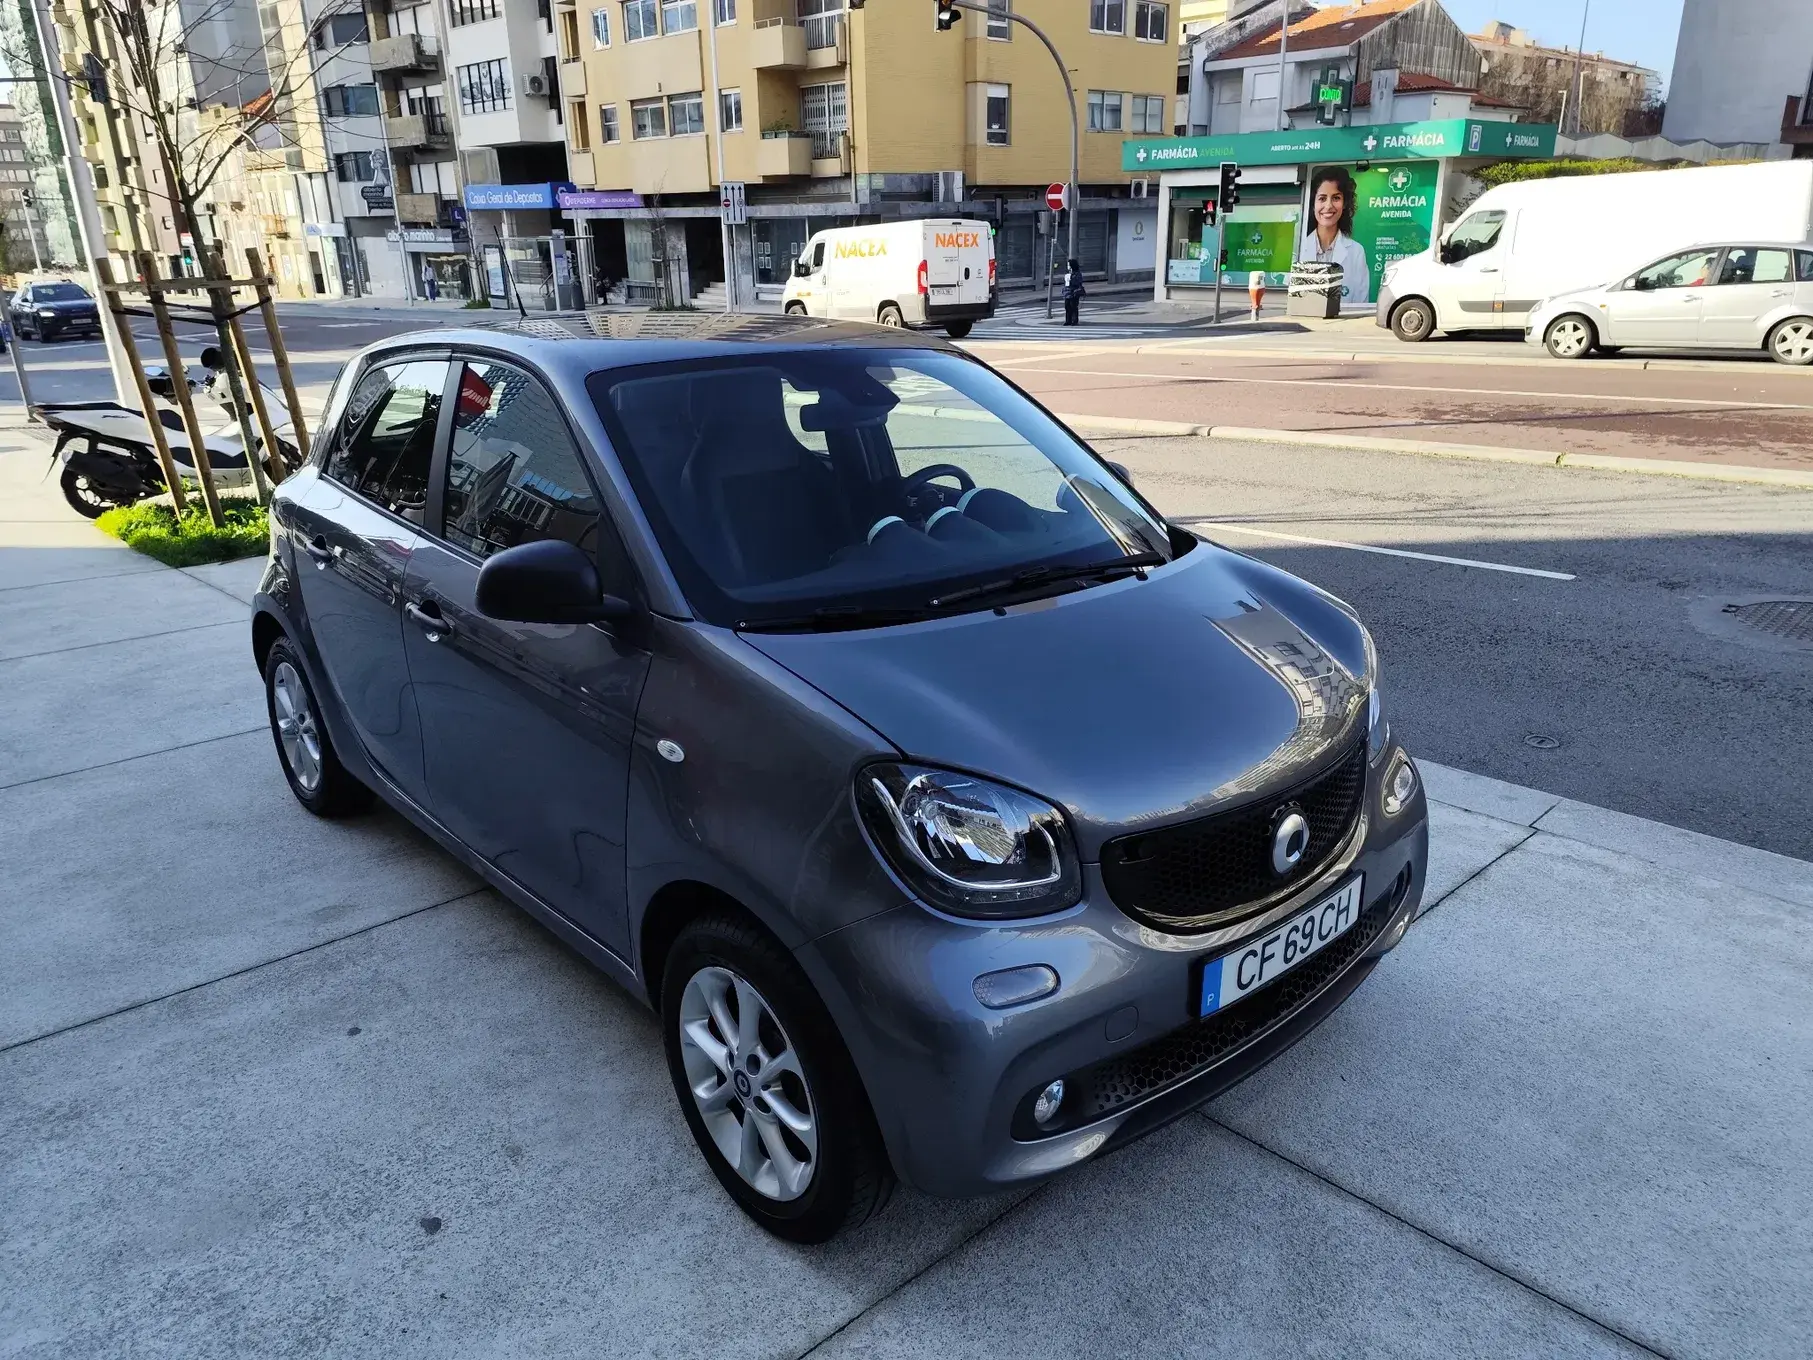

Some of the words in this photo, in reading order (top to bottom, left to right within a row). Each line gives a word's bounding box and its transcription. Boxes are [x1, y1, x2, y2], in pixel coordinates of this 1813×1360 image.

[1304, 141, 1321, 150] 24H
[1383, 130, 1445, 148] FARMÁCIA
[1514, 133, 1539, 147] FARMÁCIA
[1151, 145, 1198, 160] FARMÁCIA
[1199, 147, 1235, 157] AVENIDA
[486, 190, 504, 204] Geral
[504, 191, 513, 204] de
[1369, 194, 1427, 208] FARMÁCIA
[1381, 210, 1412, 218] AVENIDA
[935, 232, 979, 248] NACEX
[834, 238, 887, 259] NACEX
[1236, 934, 1281, 991] CF
[1283, 915, 1315, 965] 69
[1317, 888, 1352, 942] CH
[1207, 993, 1215, 1006] P
